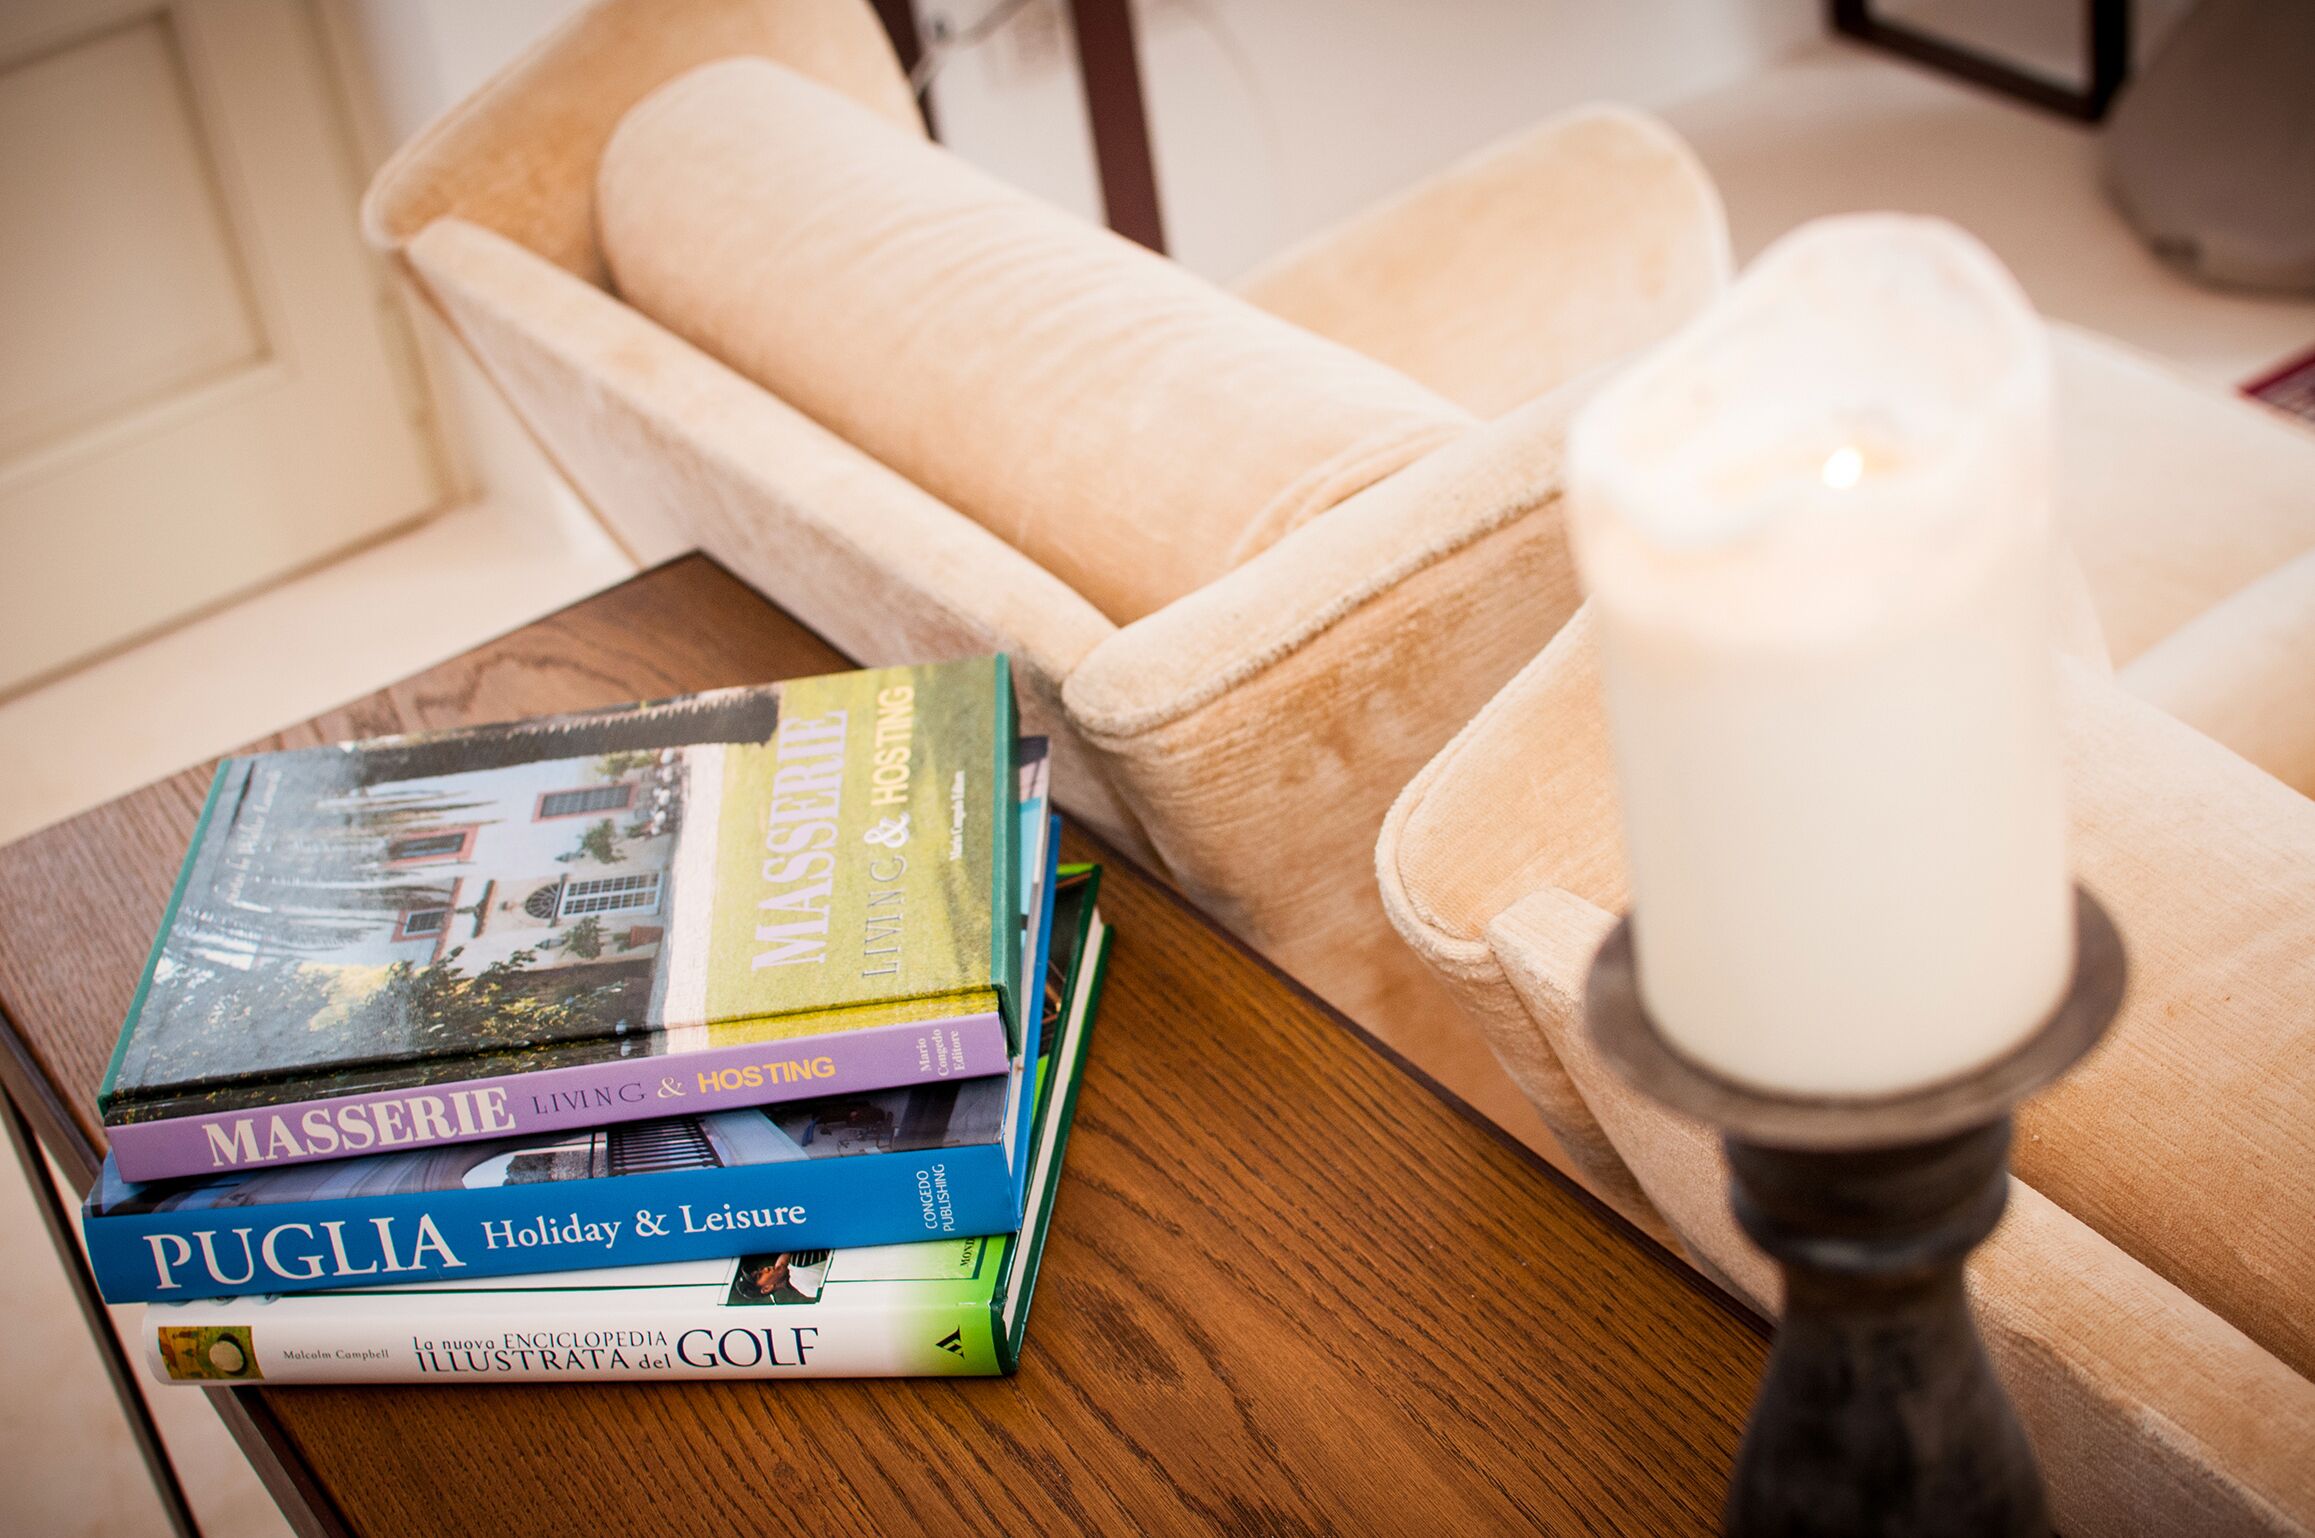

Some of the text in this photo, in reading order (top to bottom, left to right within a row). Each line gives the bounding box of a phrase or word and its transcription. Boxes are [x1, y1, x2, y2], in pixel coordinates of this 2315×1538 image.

[752, 710, 848, 971] MASSERIE
[862, 685, 915, 978] LIVING & HOSTING
[916, 1037, 932, 1073] Mario
[931, 1028, 949, 1076] Congedo
[950, 1030, 965, 1071] Editore
[202, 1056, 836, 1167] MASSERIE LIVING & HOSTING
[916, 1170, 938, 1230] CONGEDO
[932, 1163, 956, 1232] PUBLISHING
[142, 1203, 807, 1290] PUGLIA Holiday & Leisure
[283, 1348, 390, 1362] Malcolm Campbell
[413, 1329, 668, 1351] La nuova ENCICLOPEDIA
[415, 1326, 819, 1373] ILLUSTRATA del GOLF
